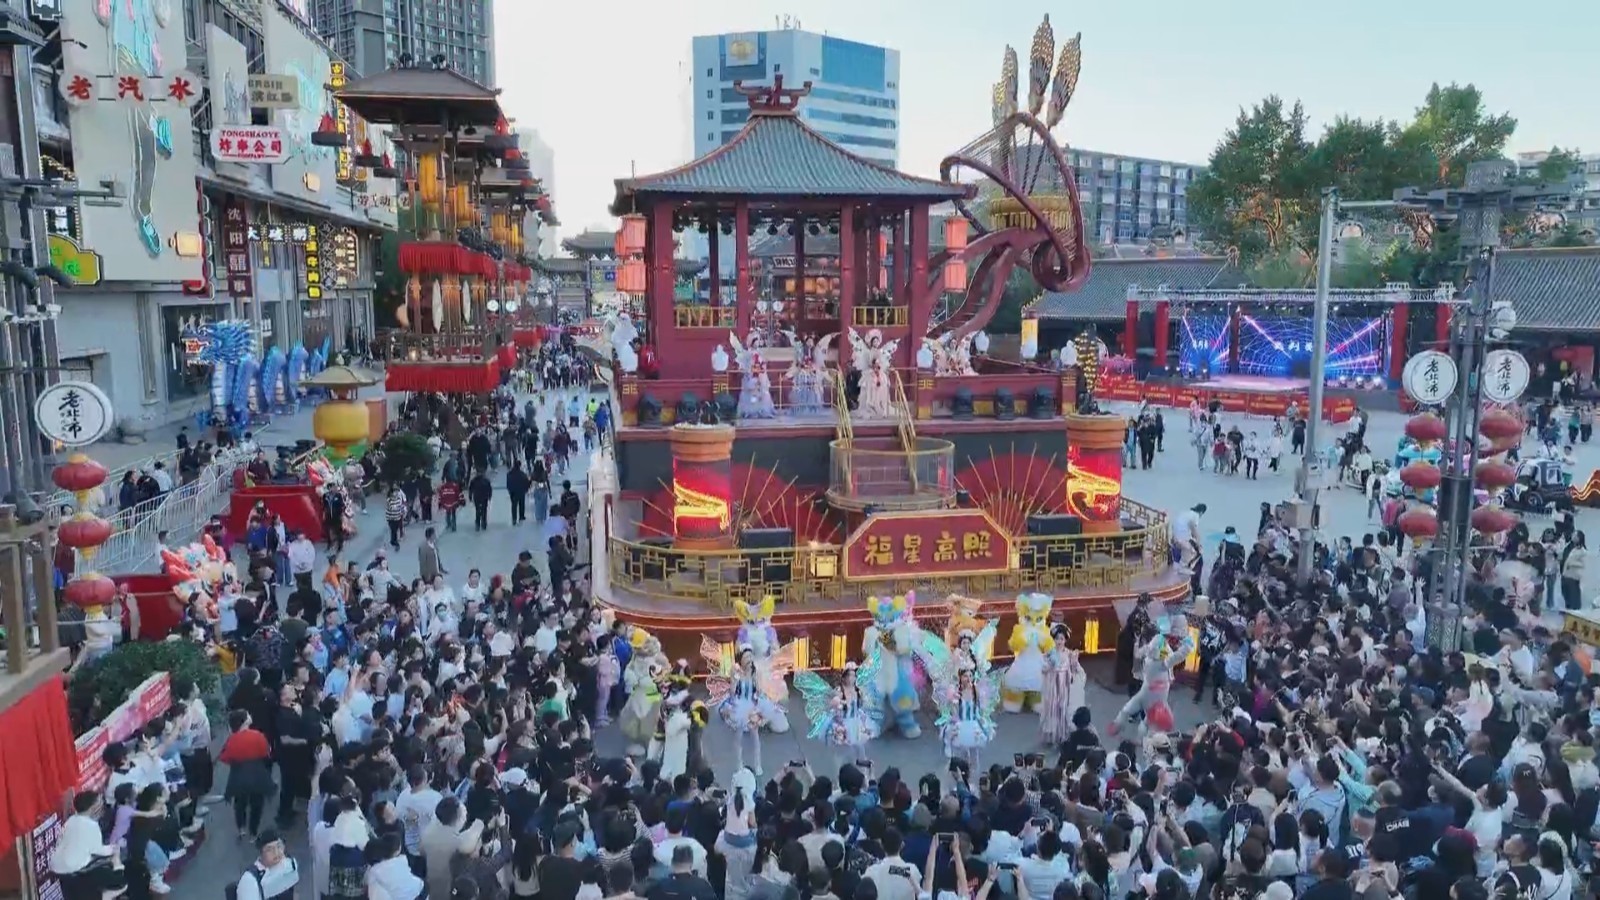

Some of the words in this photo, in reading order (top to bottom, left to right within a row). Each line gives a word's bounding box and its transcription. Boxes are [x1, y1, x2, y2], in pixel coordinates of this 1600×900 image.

[67, 75, 195, 101] 老汽水
[222, 130, 280, 138] TONGSHAOYE
[1424, 357, 1439, 397] 老北市
[1497, 357, 1513, 396] 老北市
[58, 390, 82, 439] 老北市
[863, 530, 993, 566] 福星高照
